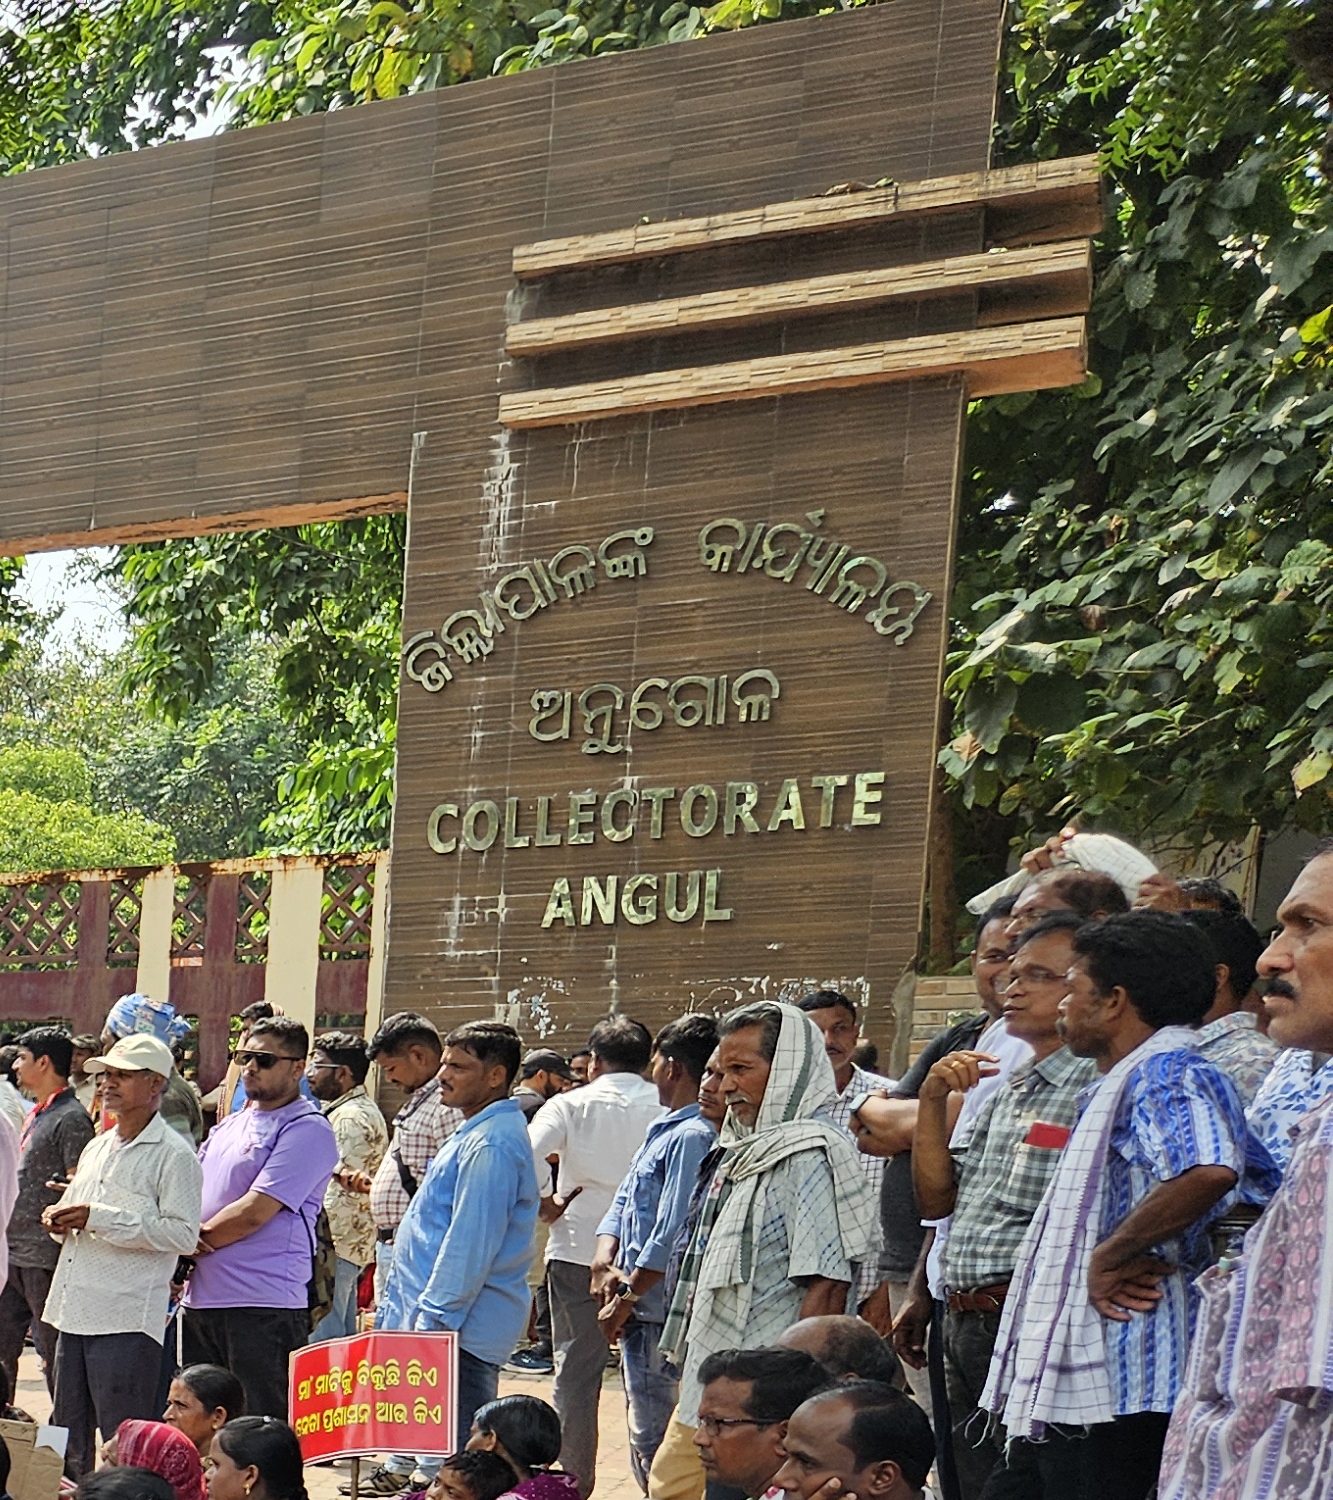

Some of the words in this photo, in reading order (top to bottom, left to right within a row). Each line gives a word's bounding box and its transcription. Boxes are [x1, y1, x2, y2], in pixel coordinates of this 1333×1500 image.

[528, 668, 780, 755] ଅନୁଗୋଳ
[427, 772, 886, 855] COLLECTORATE
[540, 868, 735, 929] ANGUL
[406, 1359, 437, 1387] କିଏ
[375, 1401, 408, 1425] ଆଉ
[413, 1397, 442, 1425] କିଏ
